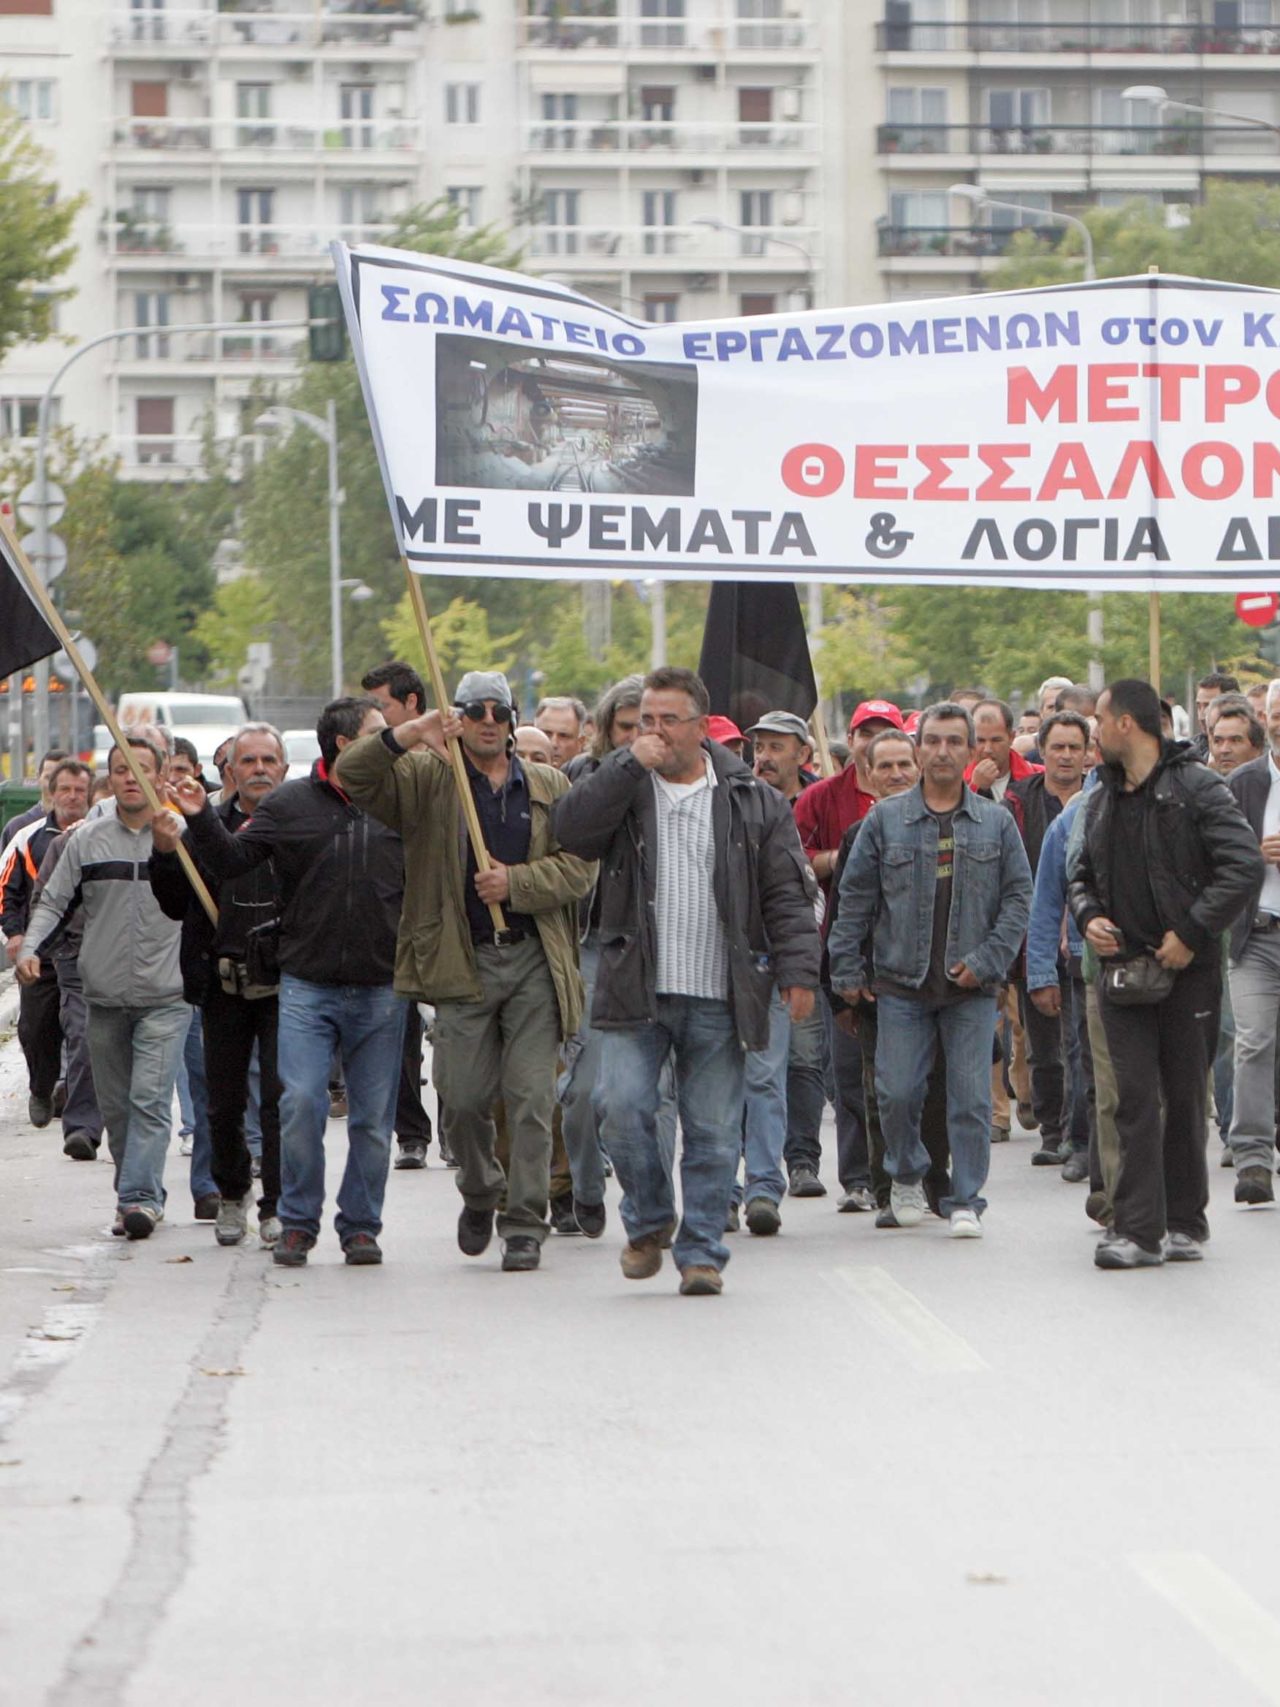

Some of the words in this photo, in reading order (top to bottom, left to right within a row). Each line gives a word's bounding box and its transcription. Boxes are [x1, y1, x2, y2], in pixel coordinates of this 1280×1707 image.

[381, 285, 646, 356] ΣΩΜΑΤΕΙΟ
[684, 311, 1081, 363] ΕΡΓΑΖΟΜΕΝΩΝ
[1103, 317, 1223, 348] στον
[396, 495, 481, 545] ΜΕ
[528, 500, 816, 558] ΨΕΜΑΤΑ
[865, 512, 915, 560] &
[961, 517, 1172, 562] ΛΟΓΙΑ
